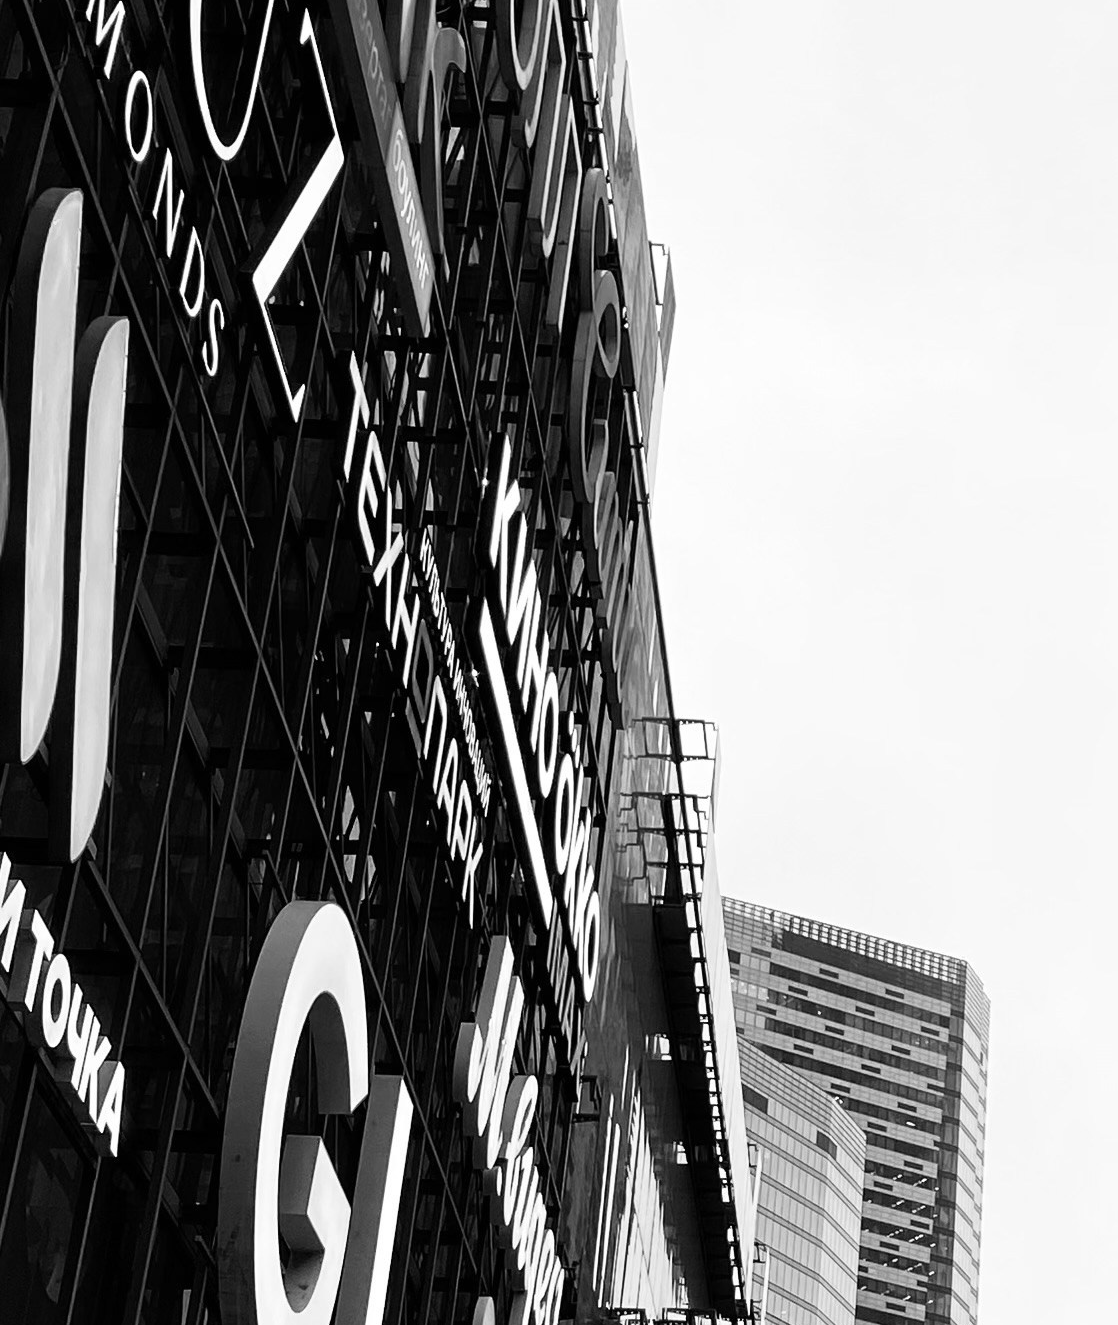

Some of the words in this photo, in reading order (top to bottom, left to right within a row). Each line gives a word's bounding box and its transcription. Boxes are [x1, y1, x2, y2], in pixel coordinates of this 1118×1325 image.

[391, 127, 430, 289] боулинг
[343, 351, 483, 929] ТЕХНОПАРК
[420, 527, 455, 678] КУЛЬТУРА
[453, 658, 492, 817] ИННОВАЦИЙ
[490, 432, 559, 798] КИНО
[24, 910, 125, 1157] ТОЧКА
[546, 897, 587, 1117] IMAX
